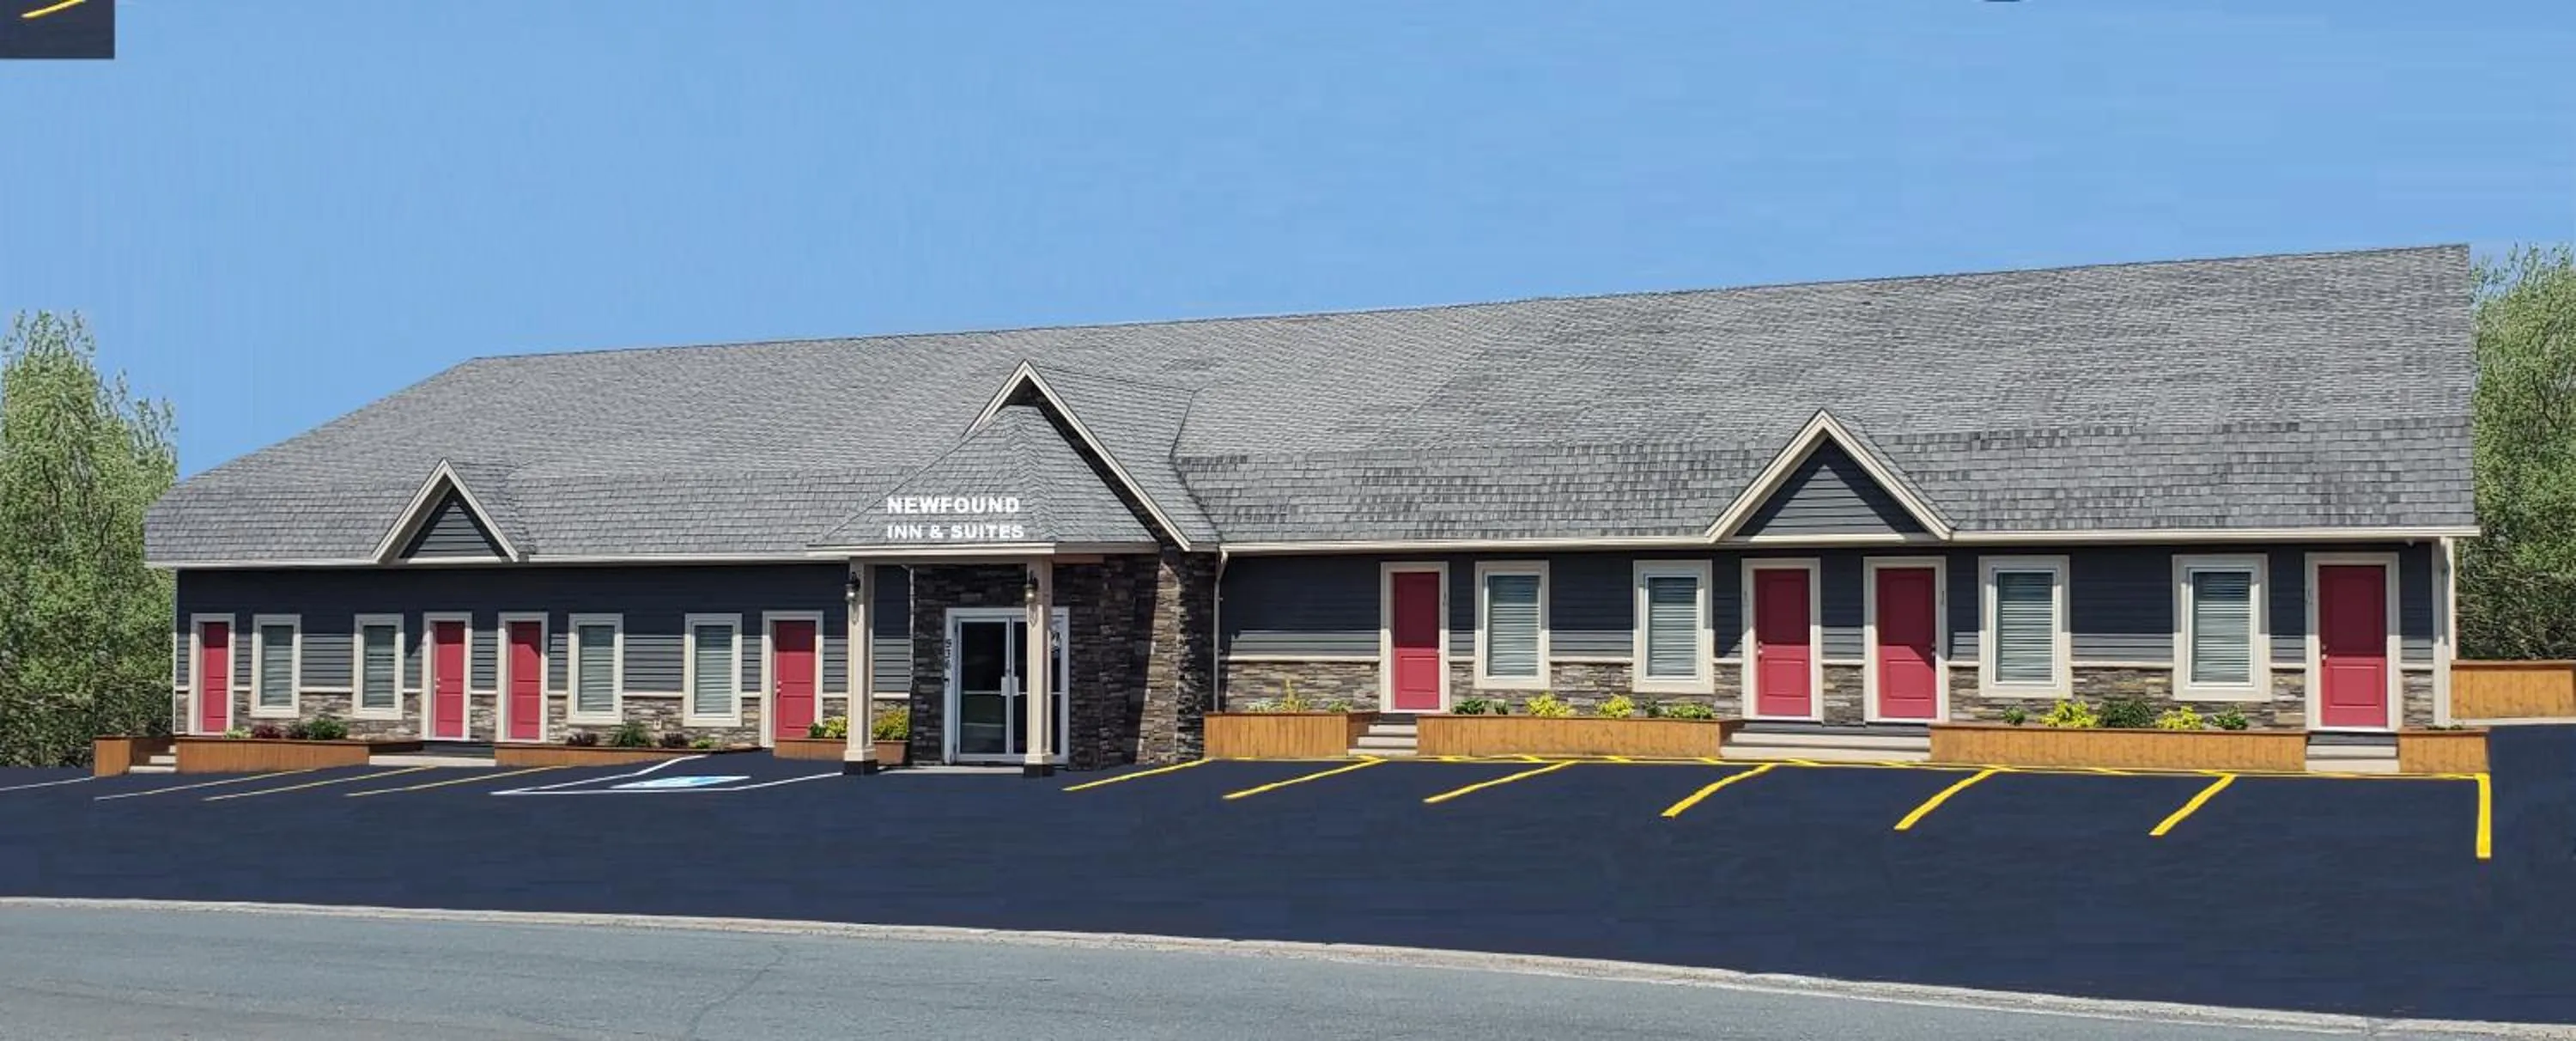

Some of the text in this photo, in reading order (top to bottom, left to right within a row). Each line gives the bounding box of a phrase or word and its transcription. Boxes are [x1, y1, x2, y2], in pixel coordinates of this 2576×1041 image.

[888, 496, 1019, 514] NEWFOUND
[888, 524, 1024, 539] INN & SUITES
